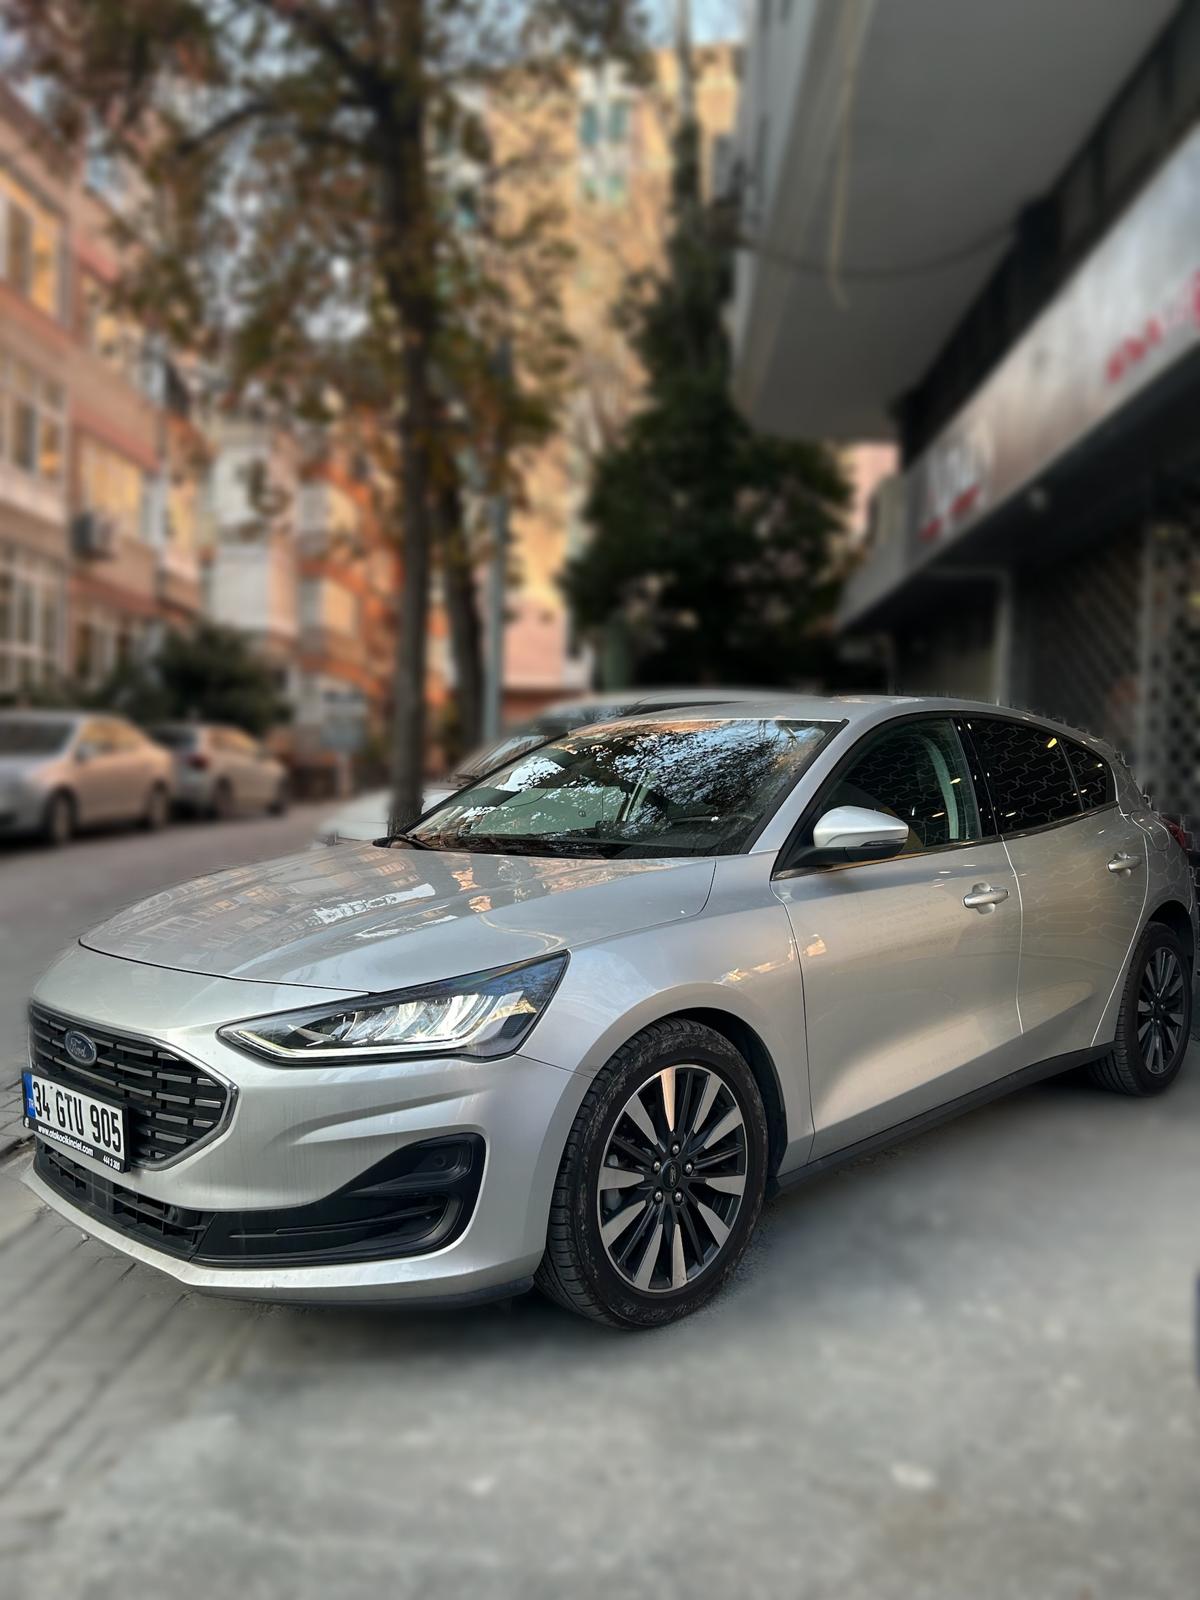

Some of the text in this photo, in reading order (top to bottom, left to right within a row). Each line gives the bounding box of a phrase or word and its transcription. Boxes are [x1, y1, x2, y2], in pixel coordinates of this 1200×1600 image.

[70, 1036, 88, 1058] Ford
[33, 1081, 121, 1153] 34 GTU 905
